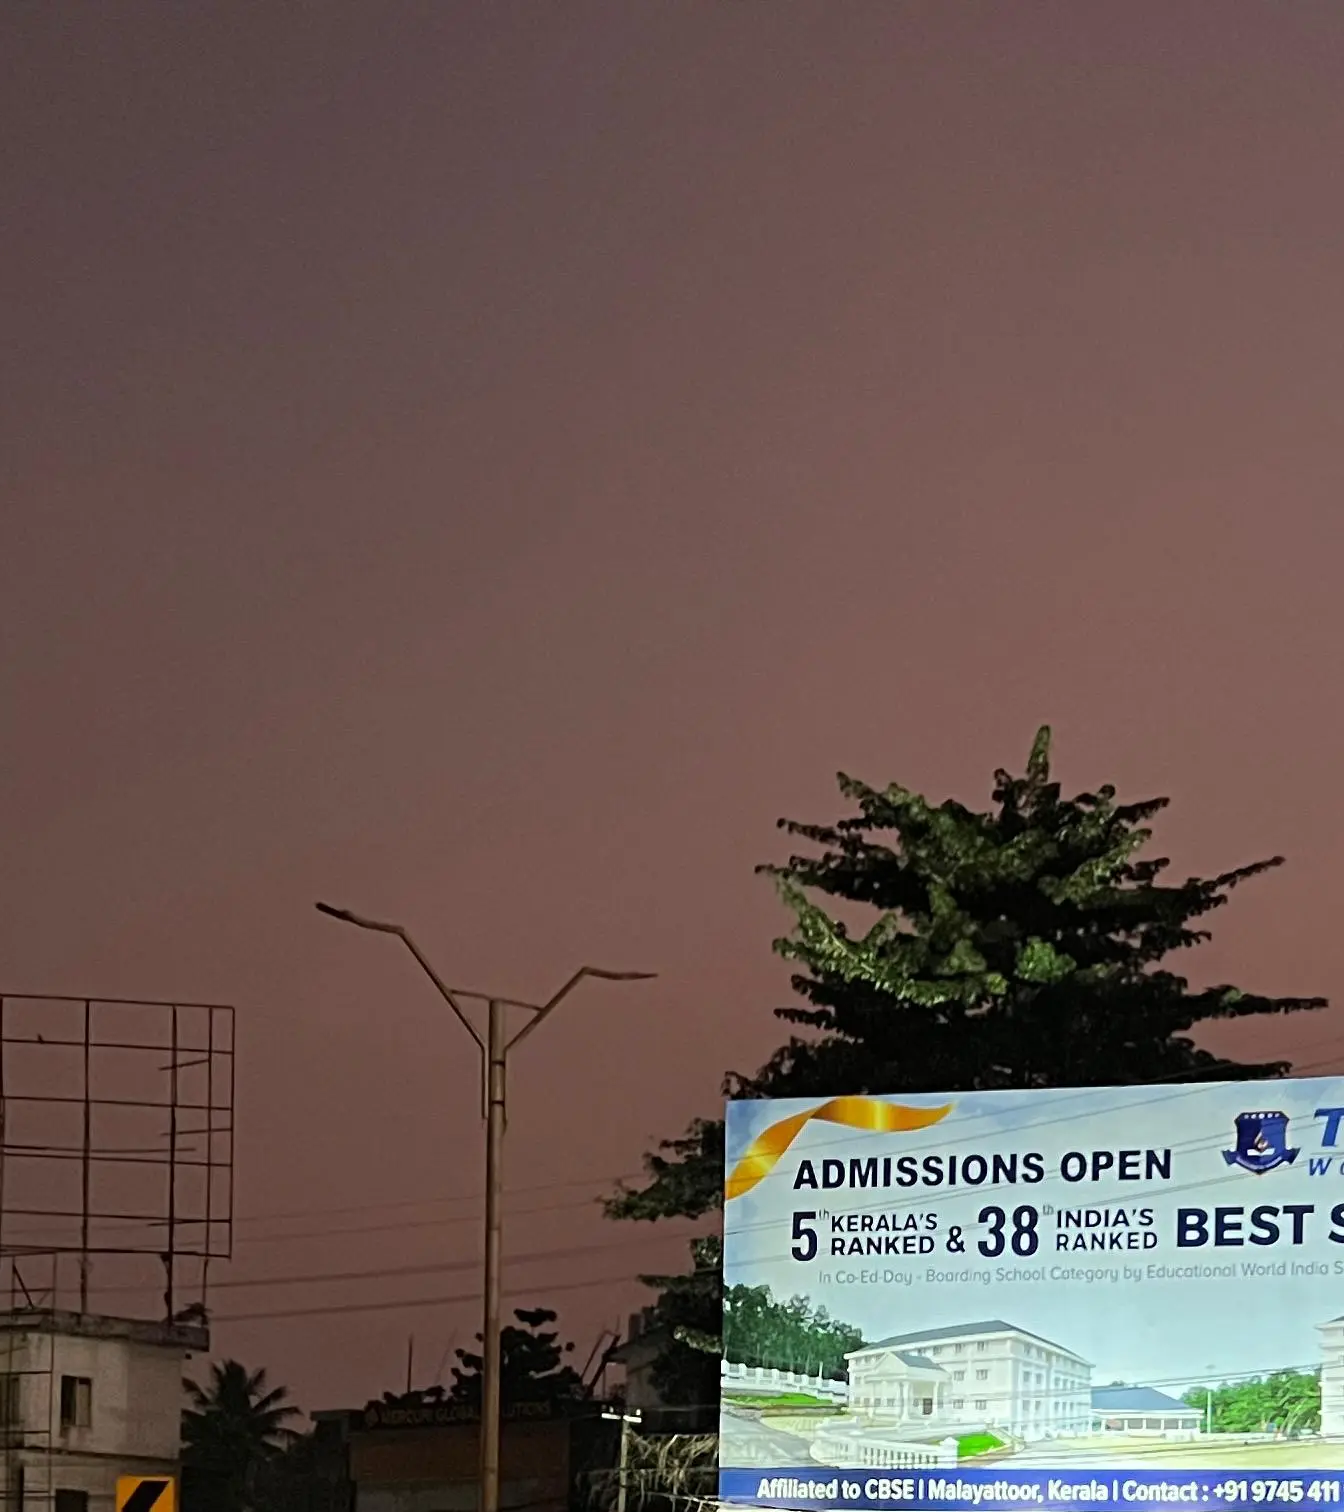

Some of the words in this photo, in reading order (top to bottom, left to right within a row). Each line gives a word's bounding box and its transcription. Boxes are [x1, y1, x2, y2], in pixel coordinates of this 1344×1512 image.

[793, 1153, 1044, 1190] ADMISSIONS
[1060, 1148, 1172, 1182] OPEN
[831, 1213, 938, 1233] KERALA'S
[1057, 1208, 1154, 1228] INDIA'S
[1176, 1204, 1314, 1248] BEST
[830, 1236, 935, 1257] RANKED
[946, 1225, 966, 1254] &
[1056, 1231, 1157, 1252] RANKED
[819, 1270, 832, 1284] In
[926, 1268, 992, 1286] Boarding
[996, 1267, 1046, 1282] School
[1051, 1265, 1119, 1283] Category
[1123, 1265, 1143, 1282] by
[1146, 1263, 1236, 1279] Educational
[1241, 1261, 1286, 1277] World
[1291, 1260, 1329, 1276] India
[757, 1478, 838, 1499] Affiliated
[842, 1479, 861, 1500] to
[865, 1479, 915, 1500] CBSE
[928, 1478, 1045, 1505] Malayattoor,
[1048, 1479, 1109, 1501] Kerala
[1122, 1480, 1199, 1502] Contact
[1213, 1480, 1248, 1503] +91
[1251, 1480, 1304, 1503] 9745
[1307, 1480, 1340, 1503] 411
